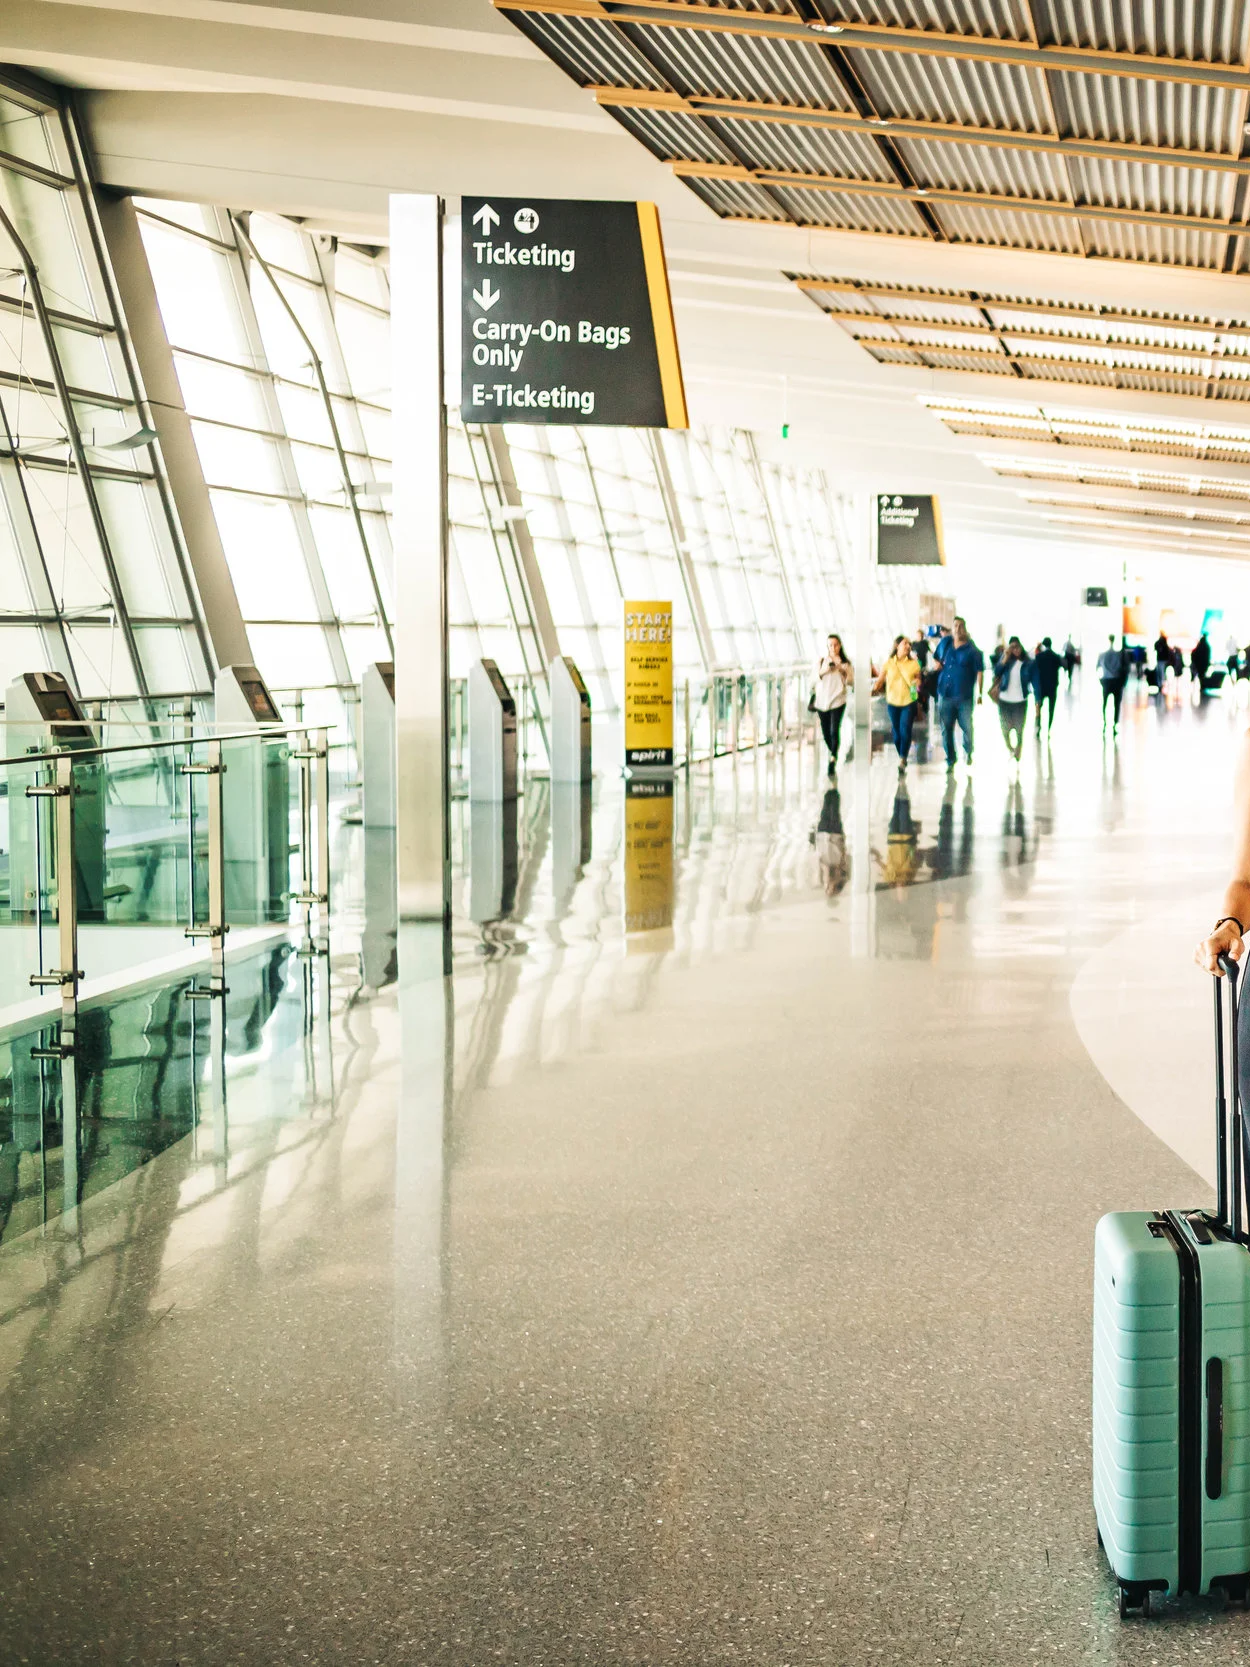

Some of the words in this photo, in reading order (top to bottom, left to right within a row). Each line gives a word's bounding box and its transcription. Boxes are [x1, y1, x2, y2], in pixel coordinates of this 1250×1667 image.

[472, 242, 576, 272] Ticketing
[472, 318, 572, 347] Carry-On
[577, 320, 632, 349] Bags
[472, 343, 524, 372] Only
[472, 384, 595, 414] E-Ticketing
[881, 507, 919, 517] Additional
[881, 516, 915, 528] Ticketing
[626, 612, 671, 627] START
[625, 627, 671, 642] HERE!
[631, 749, 666, 762] spirit
